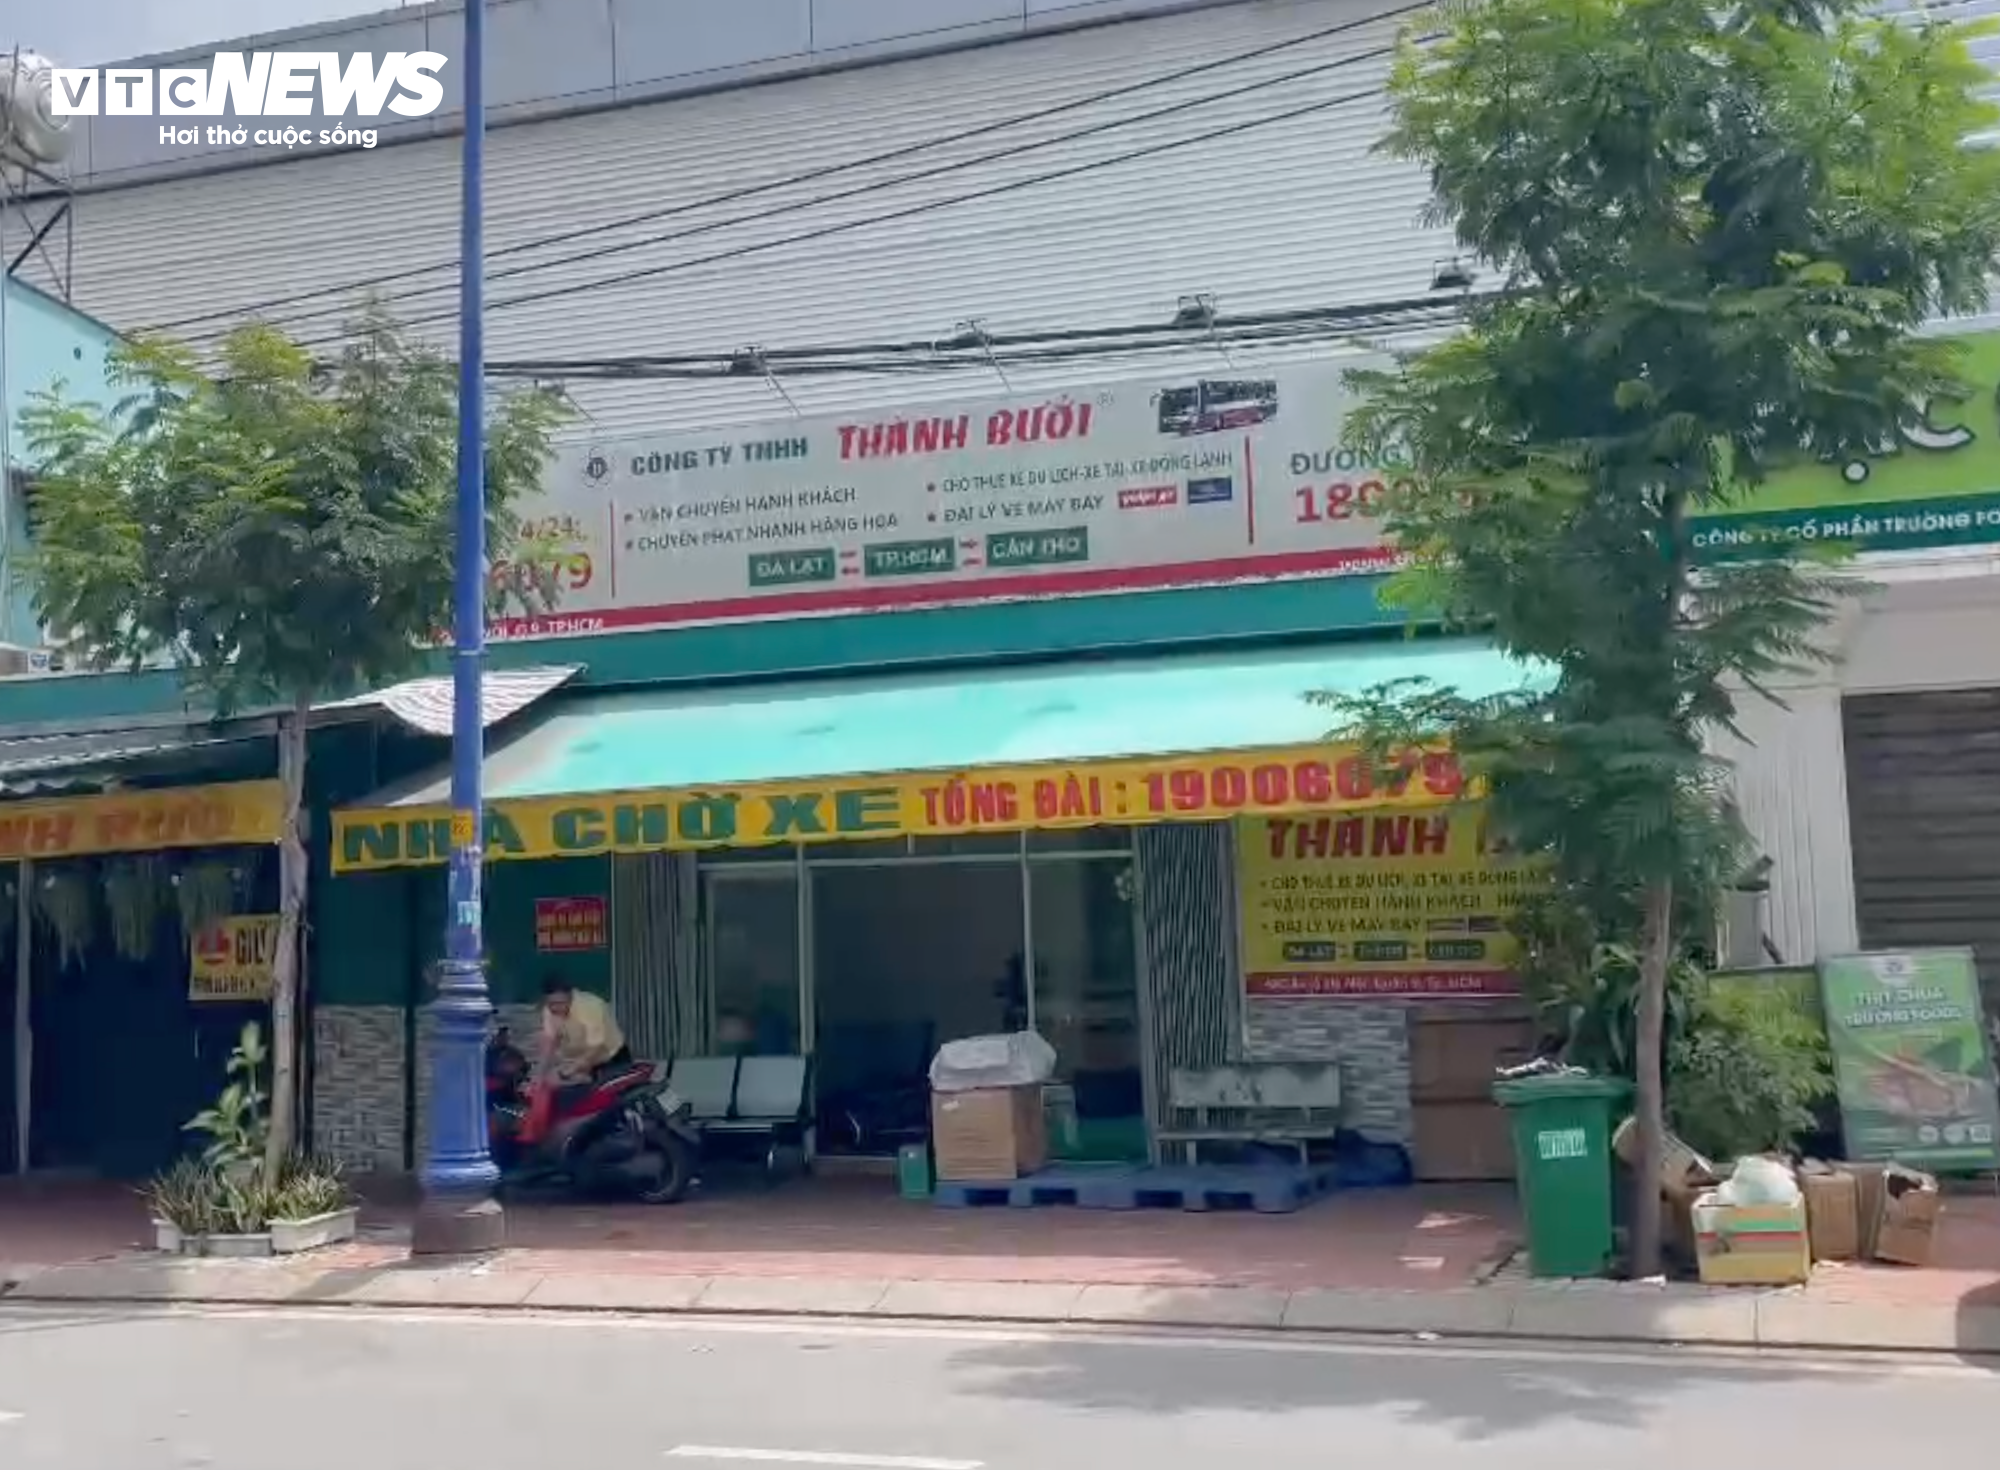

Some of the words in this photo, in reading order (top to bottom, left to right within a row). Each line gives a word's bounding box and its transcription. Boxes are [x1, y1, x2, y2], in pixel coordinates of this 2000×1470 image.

[552, 791, 739, 850] CHỜ
[764, 787, 903, 837] XE
[1033, 770, 1101, 820] ĐÀI
